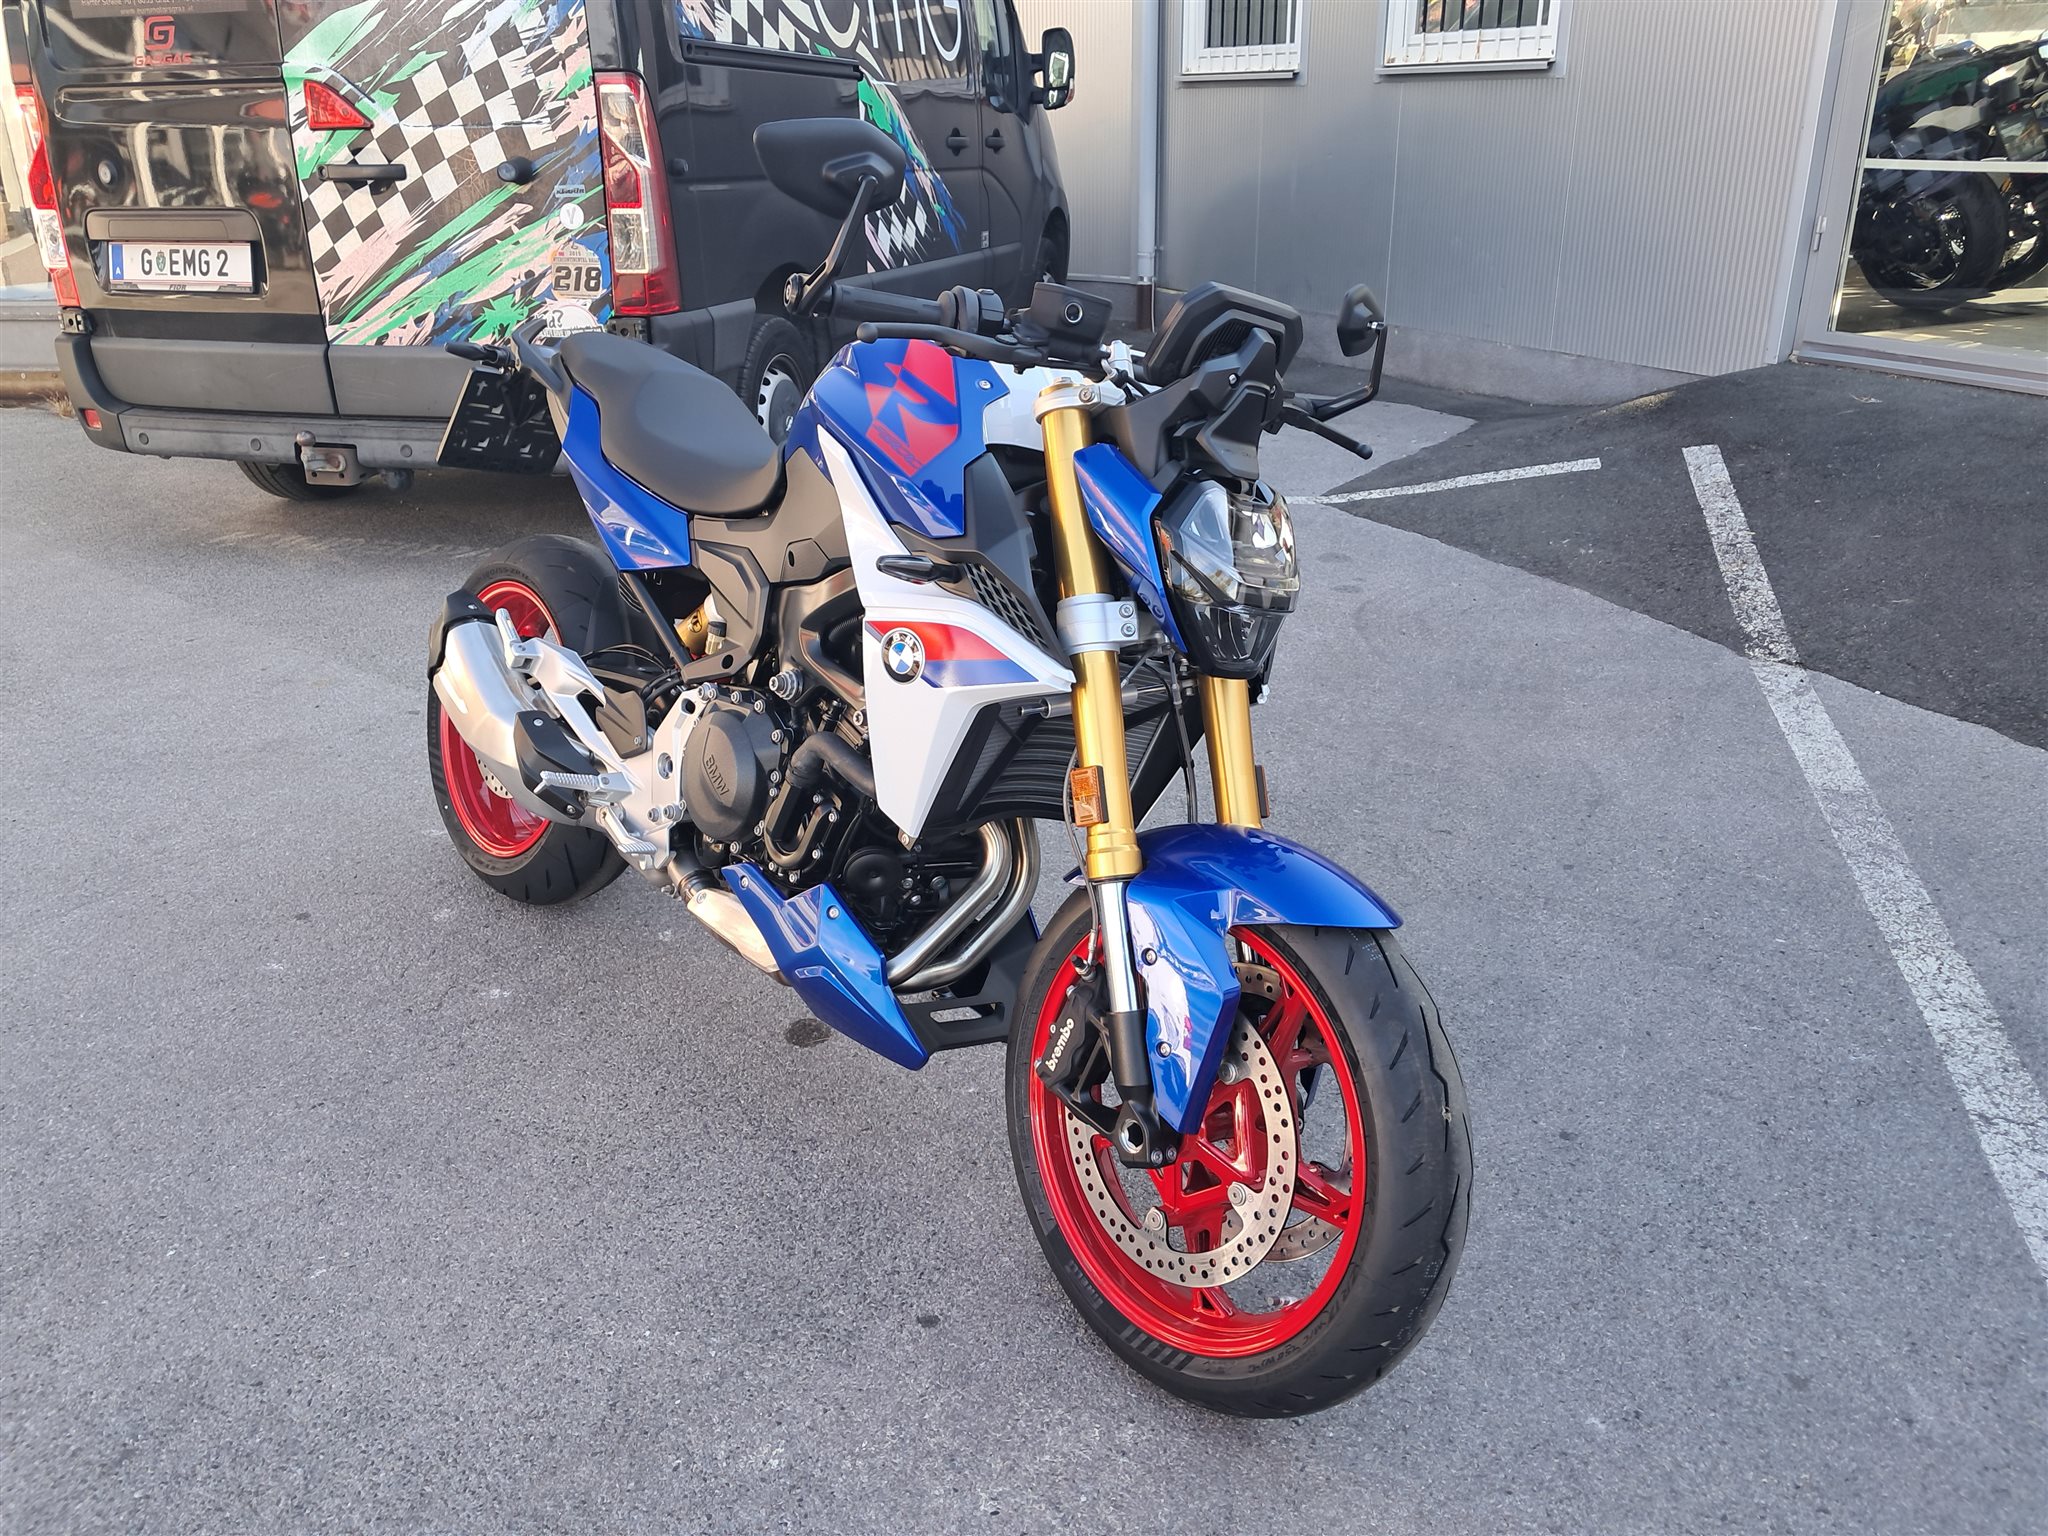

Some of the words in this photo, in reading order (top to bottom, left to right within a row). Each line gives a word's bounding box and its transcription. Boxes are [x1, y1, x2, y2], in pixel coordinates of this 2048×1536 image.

[141, 248, 153, 276] G
[169, 249, 211, 277] EMG
[216, 249, 229, 277] 2
[553, 265, 601, 293] 218
[705, 754, 730, 796] BMW
[1045, 1018, 1075, 1072] brembo
